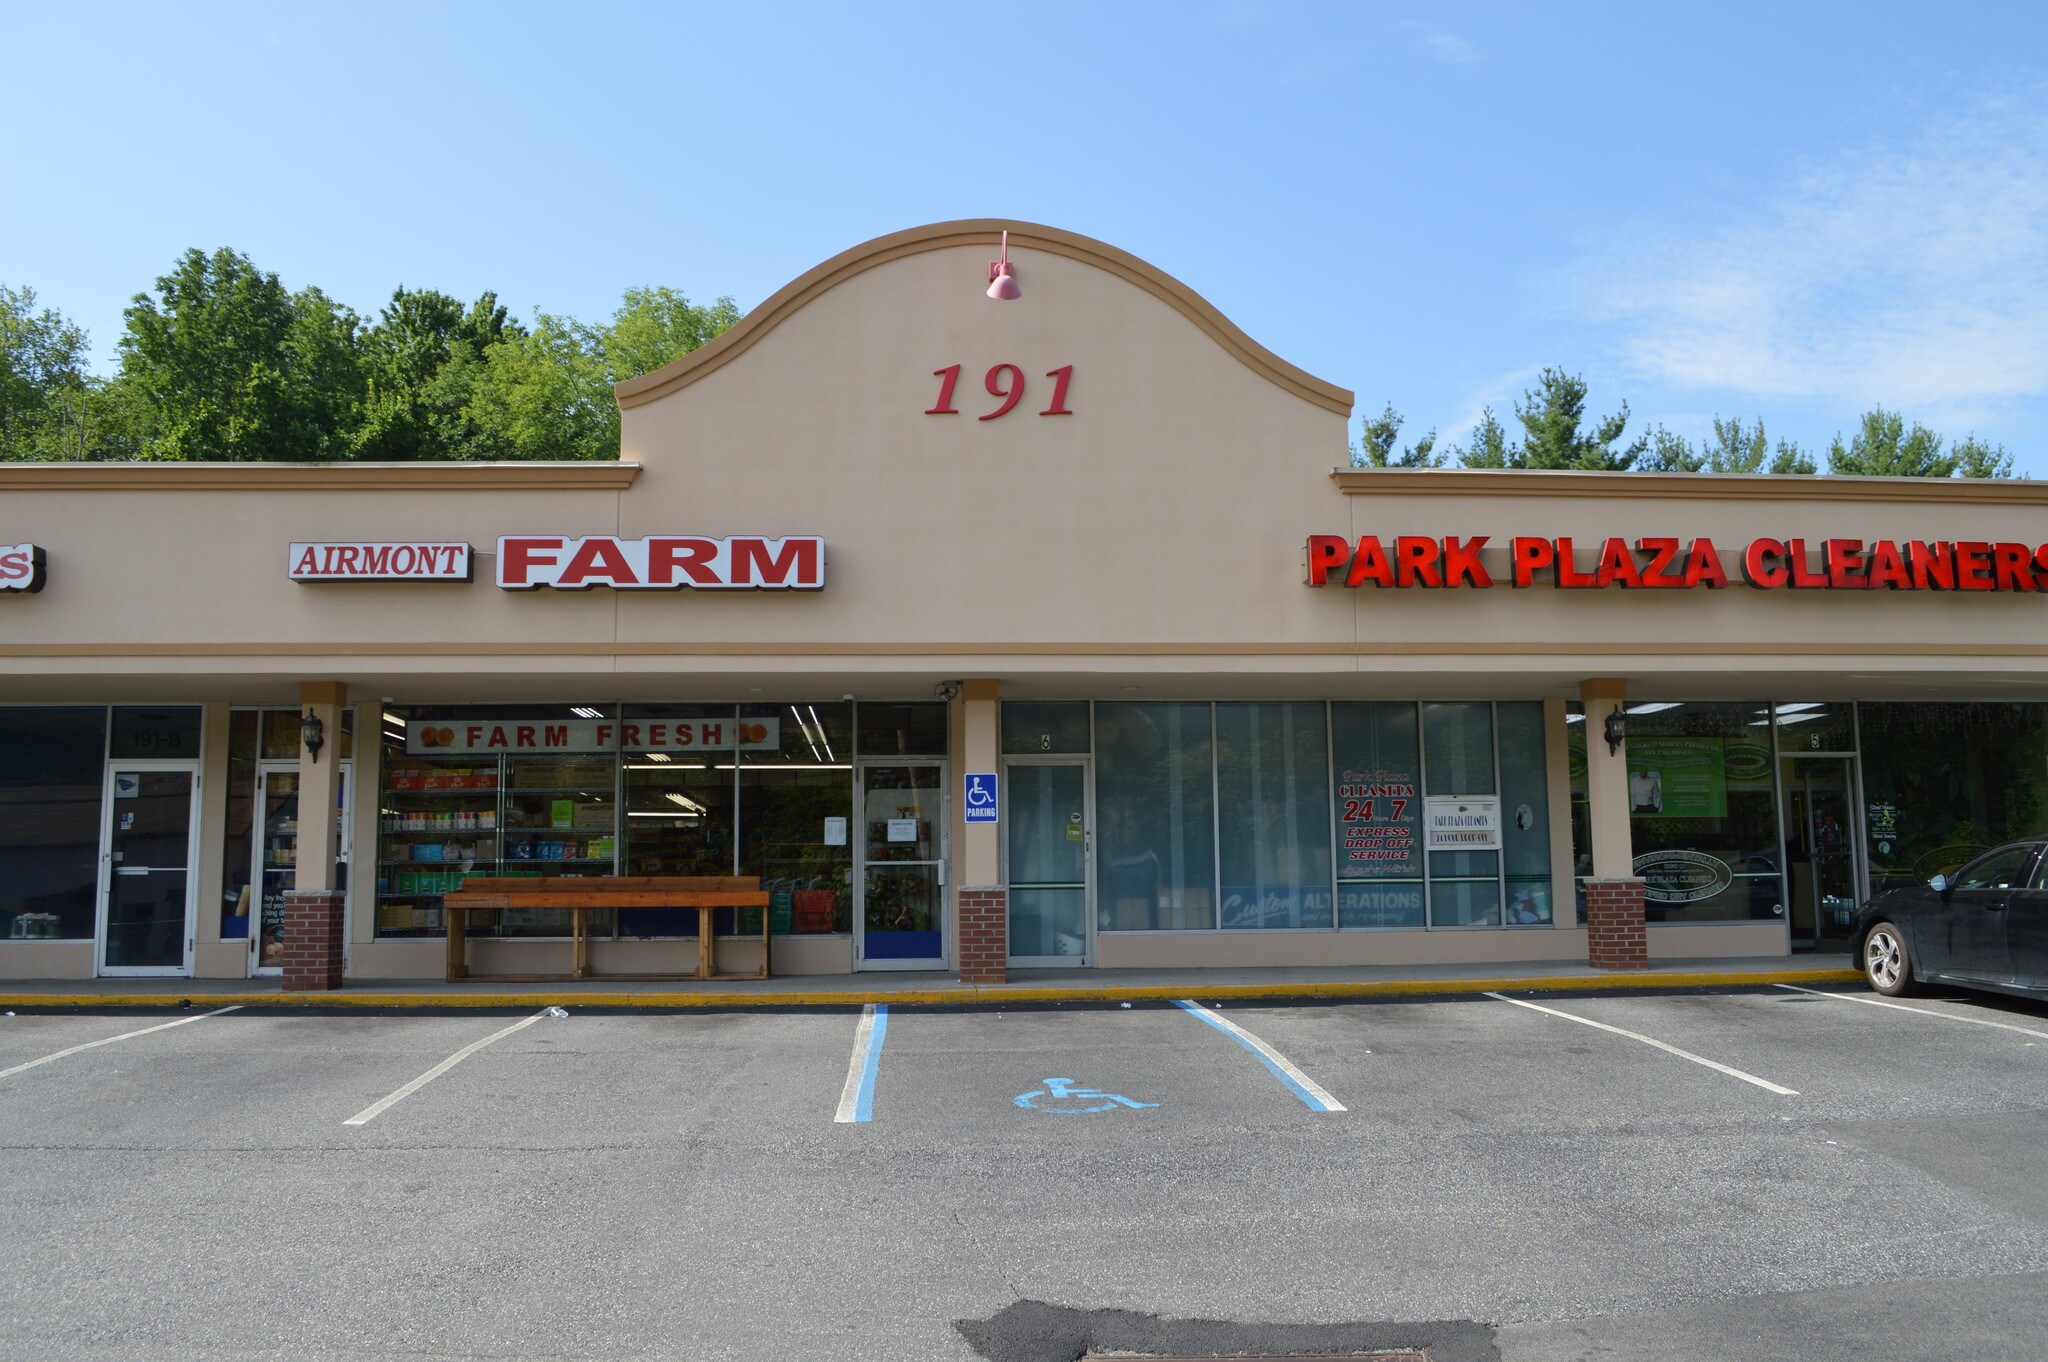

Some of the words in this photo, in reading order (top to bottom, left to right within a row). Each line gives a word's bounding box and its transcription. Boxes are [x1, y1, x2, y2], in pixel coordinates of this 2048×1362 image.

[925, 363, 1073, 421] 191
[293, 545, 464, 576] AIRMONT
[502, 538, 818, 584] FARM
[1303, 535, 1494, 588] PARK
[1508, 536, 1728, 589] PLAZA
[132, 732, 181, 748] 191-8
[466, 726, 568, 748] FARM
[597, 724, 722, 747] FRESH
[1042, 735, 1050, 749] 6
[1811, 734, 1819, 747] 5
[1339, 784, 1415, 797] CLEANERS
[967, 807, 996, 818] PARKING
[1342, 800, 1374, 822] 24
[1391, 800, 1407, 822] 7
[1346, 827, 1411, 838] EXPRESS
[1344, 838, 1383, 849] DROP
[1386, 838, 1414, 849] OFF
[1349, 850, 1409, 861] SERVICE
[1304, 893, 1420, 909] ALTERATIONS
